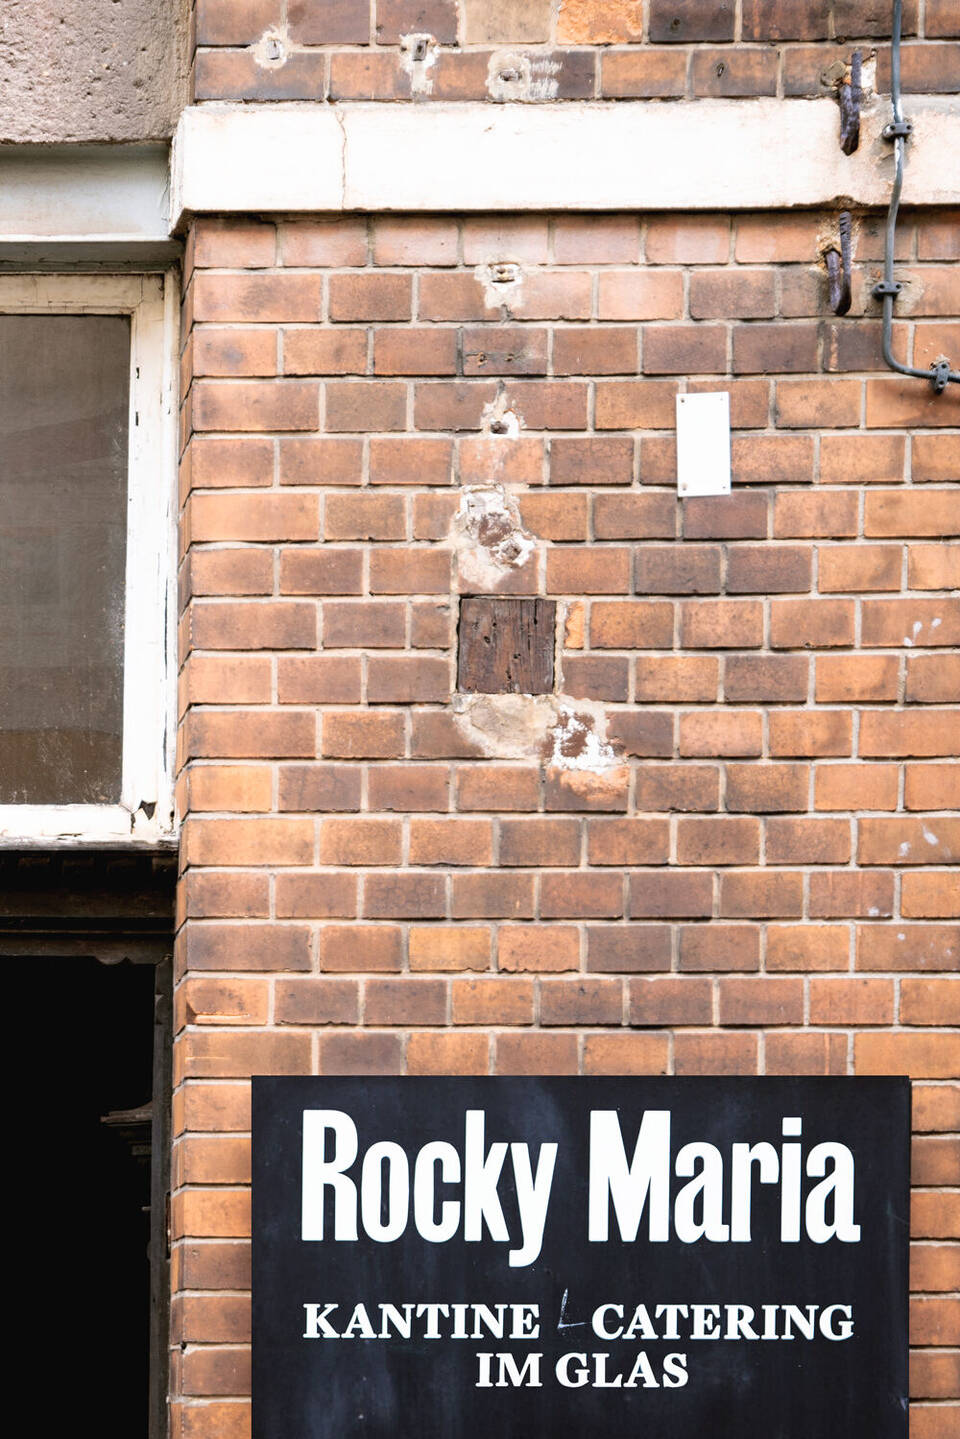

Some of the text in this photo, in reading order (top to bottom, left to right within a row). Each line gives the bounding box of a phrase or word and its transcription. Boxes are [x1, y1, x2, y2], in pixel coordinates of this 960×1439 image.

[301, 1109, 861, 1268] Rocky Maria
[302, 1303, 855, 1341] KANTINE CATERING
[475, 1352, 690, 1389] IM GLAS
